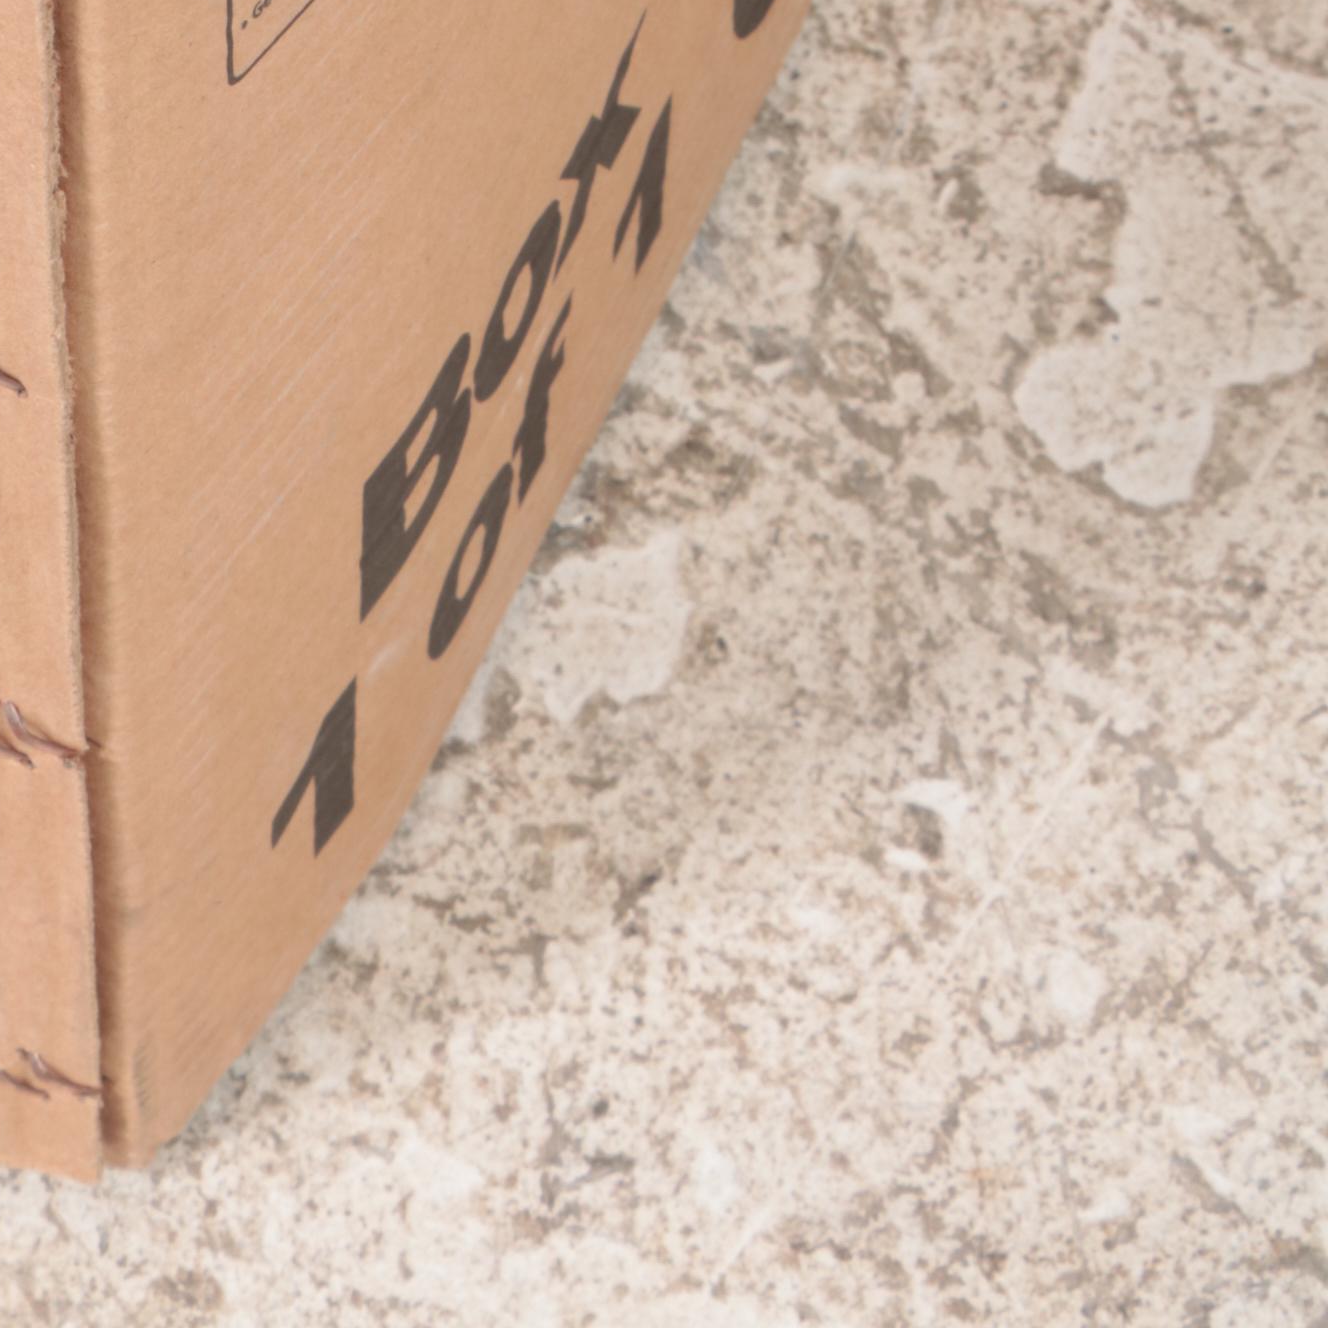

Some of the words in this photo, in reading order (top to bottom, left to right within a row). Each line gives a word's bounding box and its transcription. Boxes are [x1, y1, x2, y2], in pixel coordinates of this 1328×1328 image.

[271, 676, 357, 859] 1
[427, 290, 574, 661] of
[612, 93, 672, 277] 1
[358, 7, 647, 625] Box
